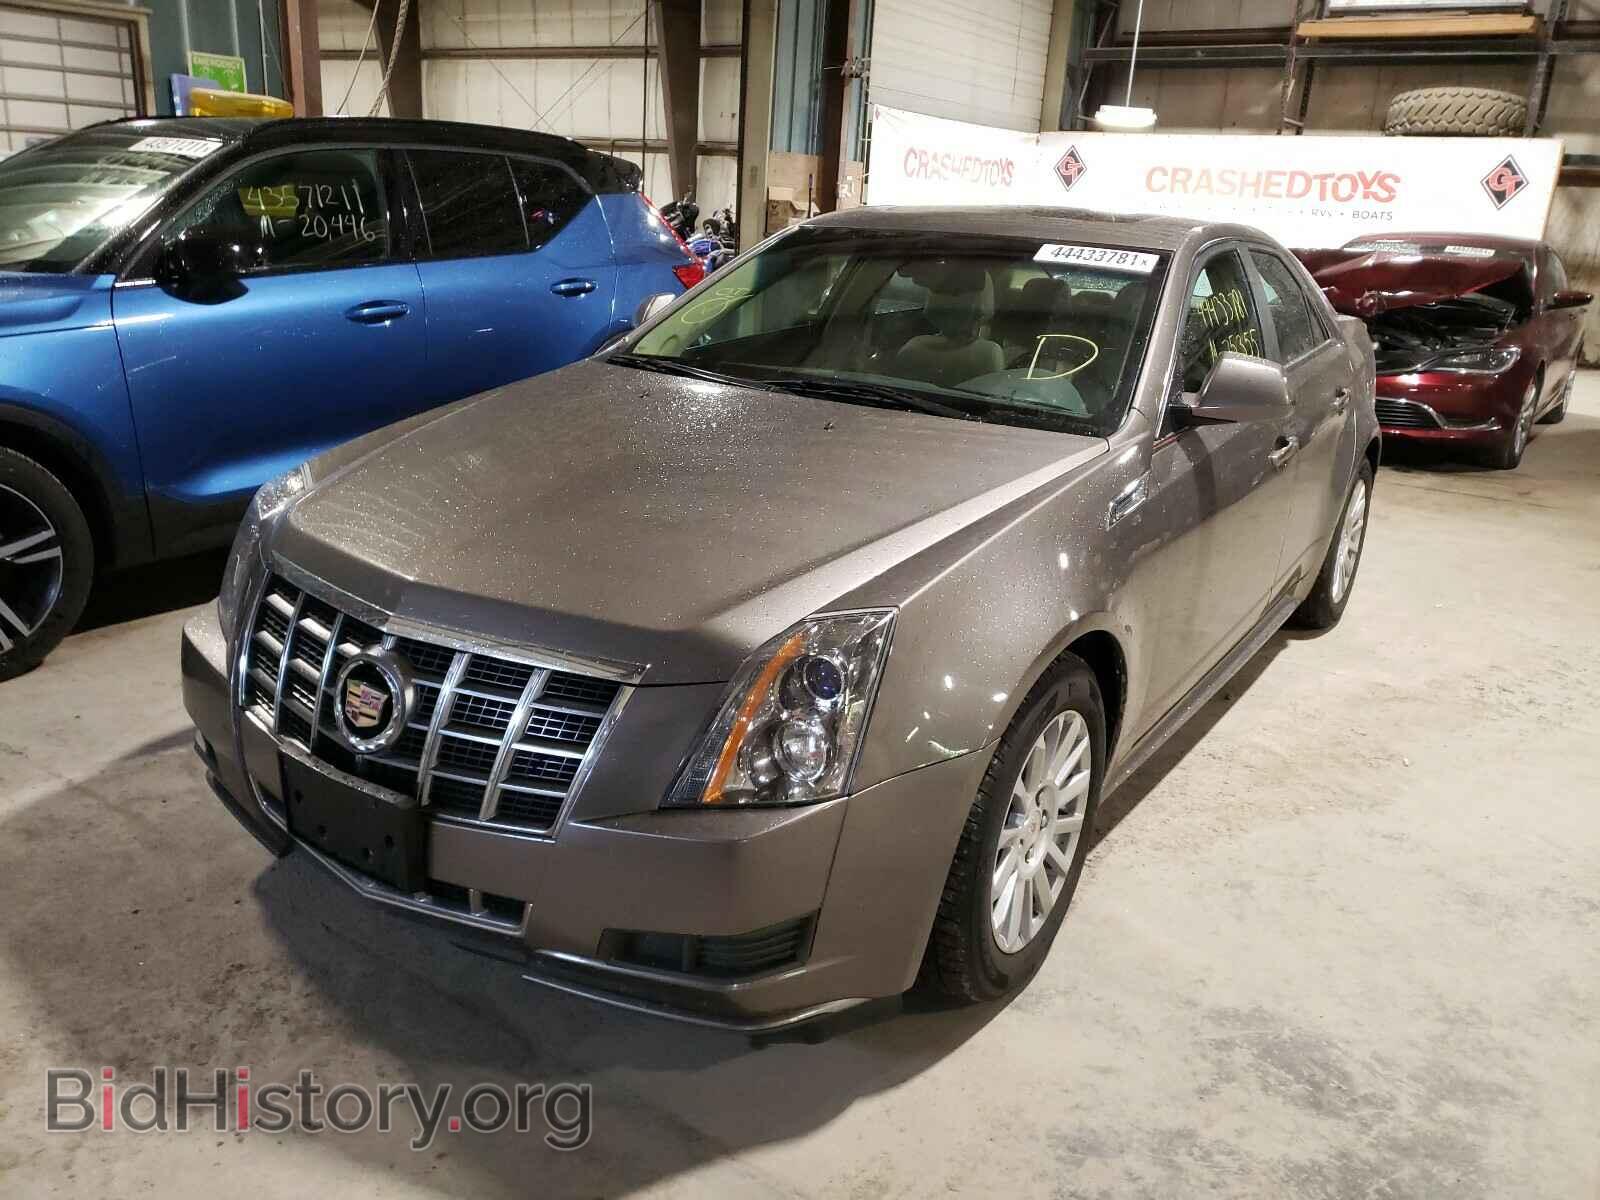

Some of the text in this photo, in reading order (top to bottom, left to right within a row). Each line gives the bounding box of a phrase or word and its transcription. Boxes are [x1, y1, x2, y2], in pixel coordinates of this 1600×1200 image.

[903, 147, 1015, 187] CRASHEDTOYS
[1144, 166, 1401, 203] CRASHEDTOYS
[248, 178, 365, 215] 43571211
[299, 213, 376, 242] 20,446
[1352, 210, 1393, 221] BOATS
